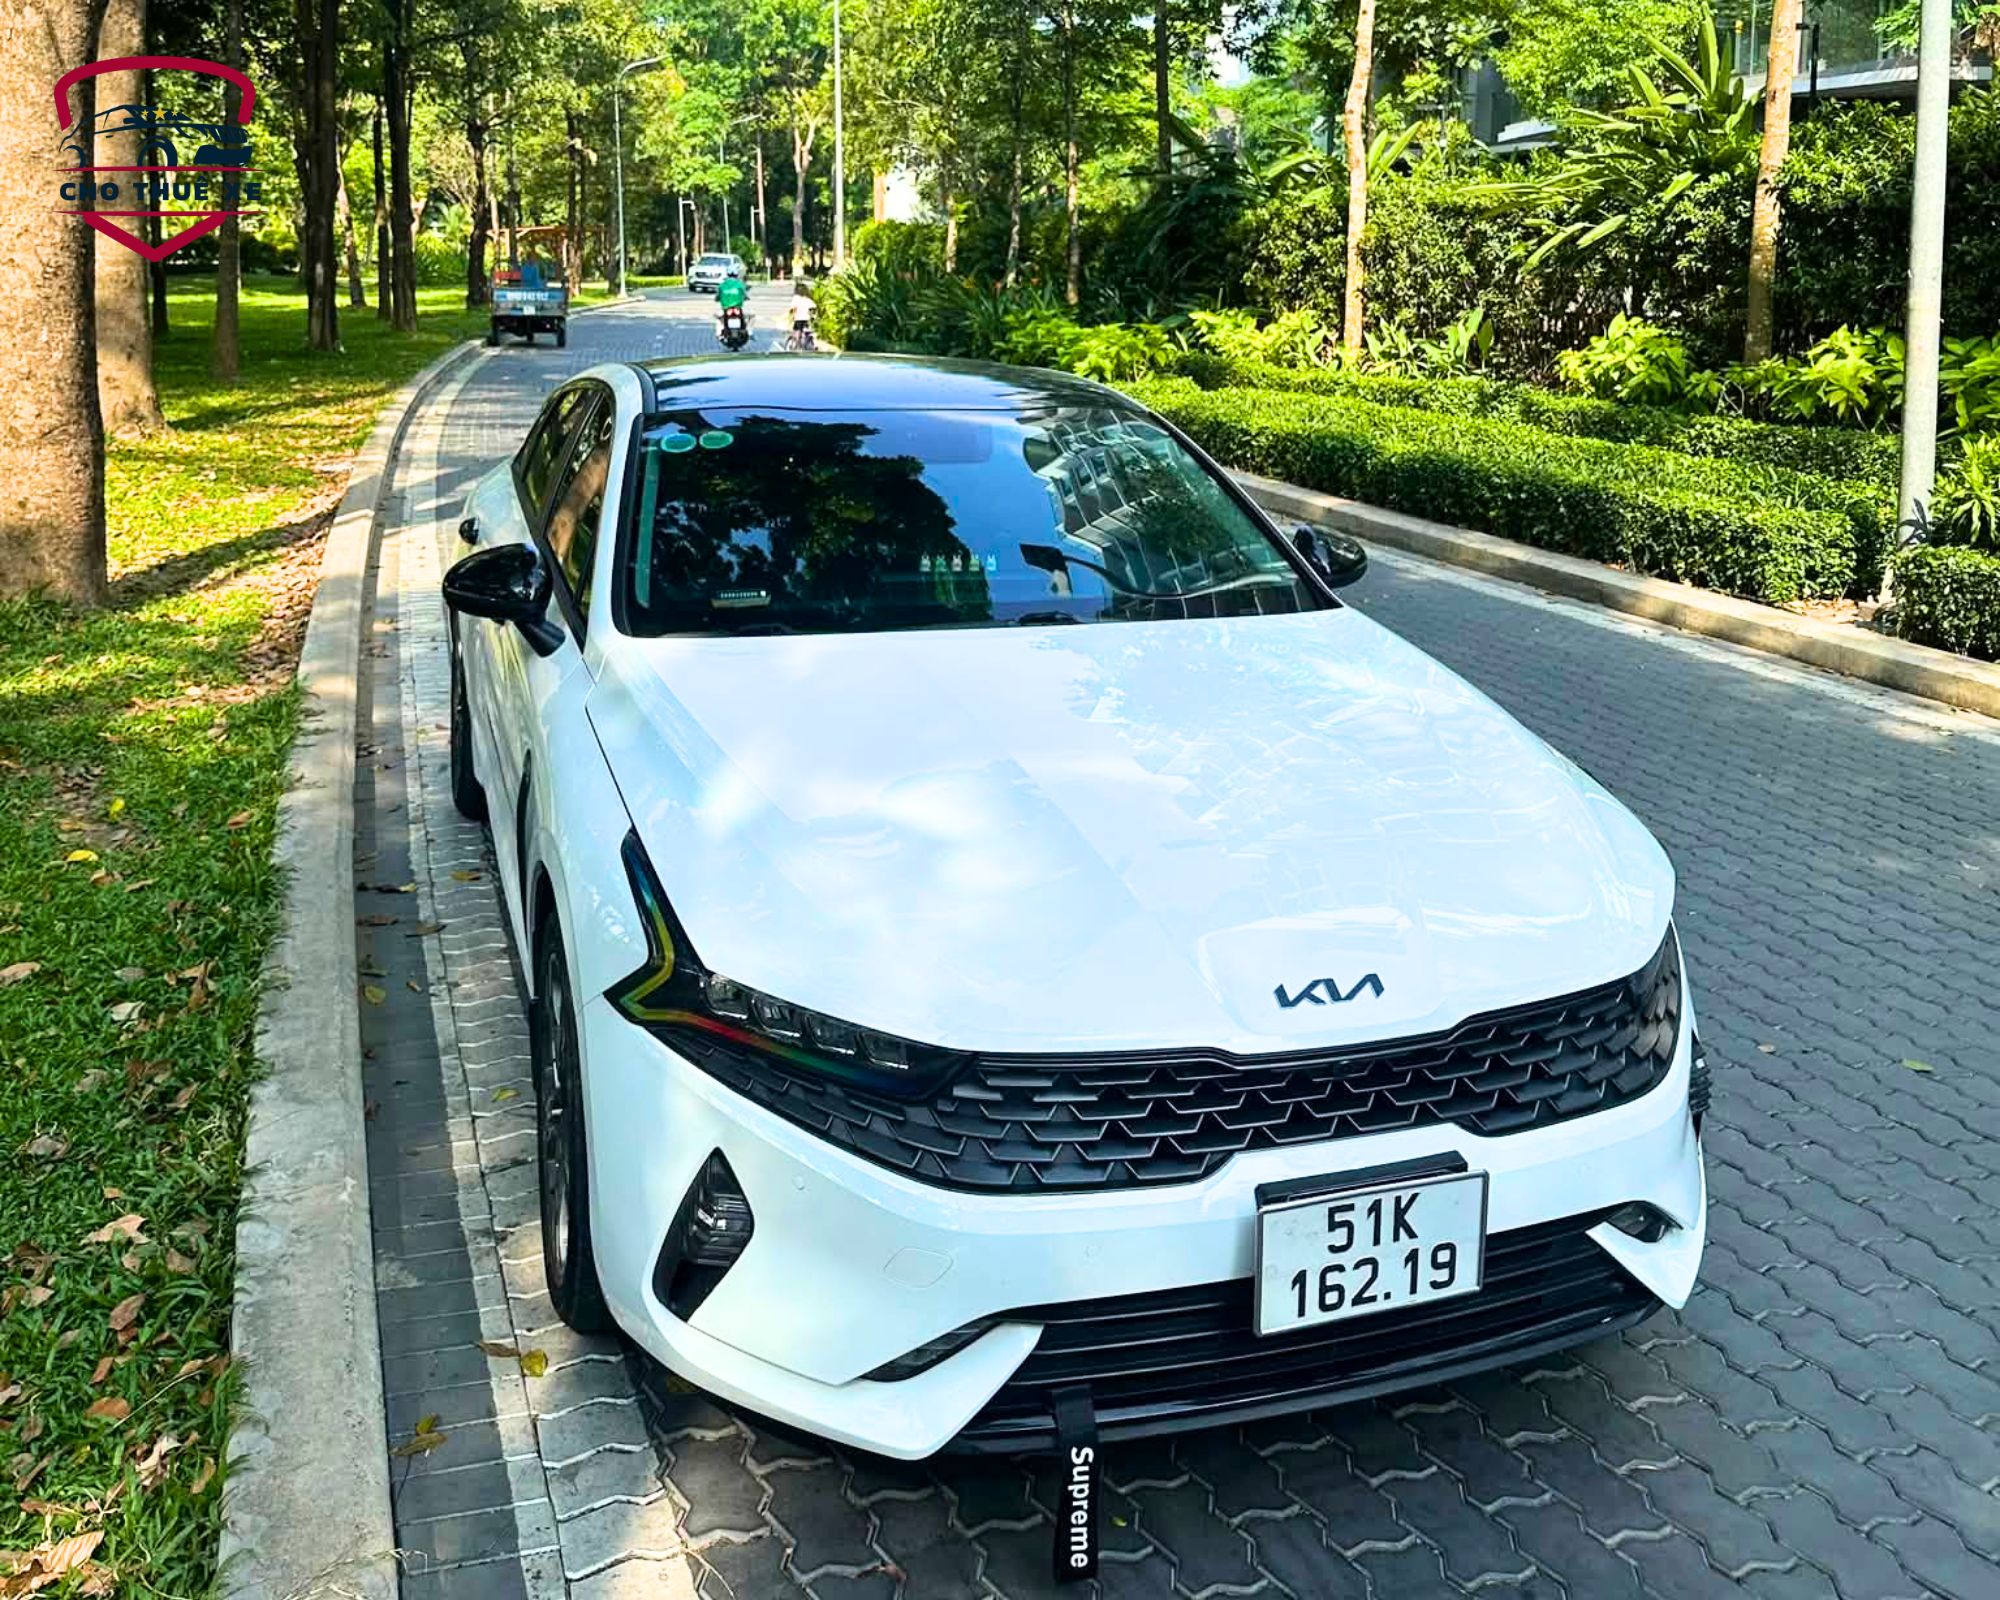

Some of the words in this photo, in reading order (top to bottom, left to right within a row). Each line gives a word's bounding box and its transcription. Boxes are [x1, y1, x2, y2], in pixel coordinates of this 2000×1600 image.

[1327, 1191, 1422, 1254] 51K
[1291, 1241, 1457, 1319] 162.19
[1067, 1446, 1095, 1568] Supreme
